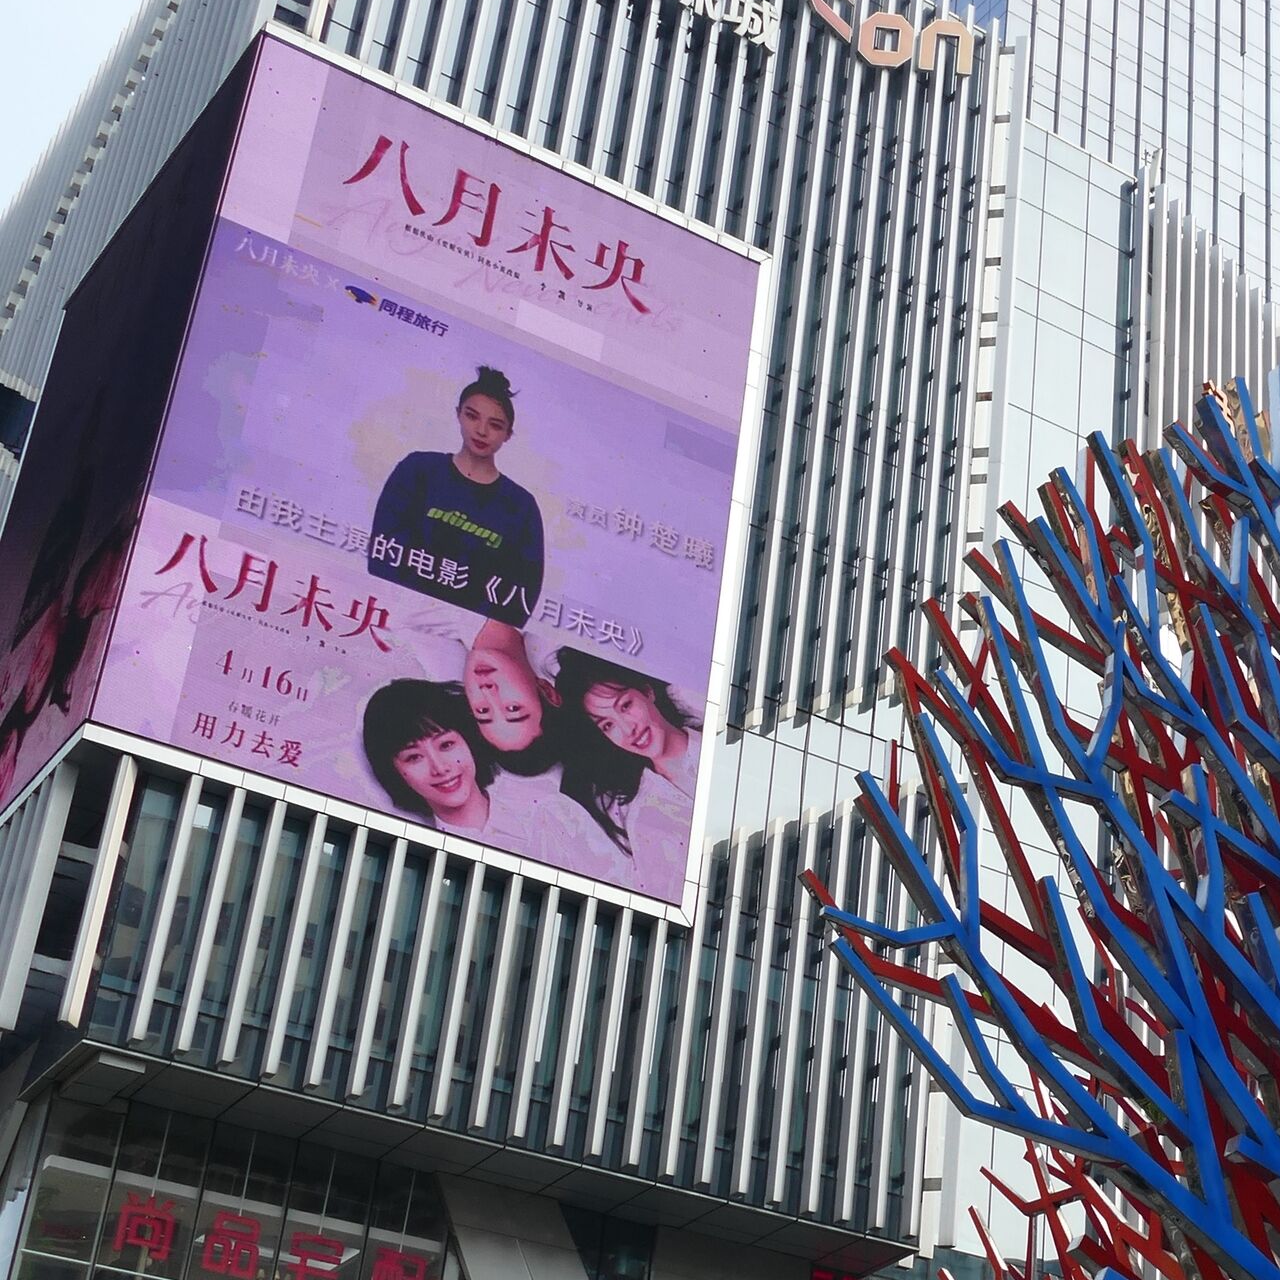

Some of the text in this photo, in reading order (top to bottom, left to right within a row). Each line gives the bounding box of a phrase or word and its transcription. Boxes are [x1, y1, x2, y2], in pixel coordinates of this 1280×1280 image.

[342, 134, 652, 316] 八月未央
[378, 296, 449, 338] 同程旅行
[155, 531, 394, 653] 八月未央
[191, 711, 304, 768] 用力去爱
